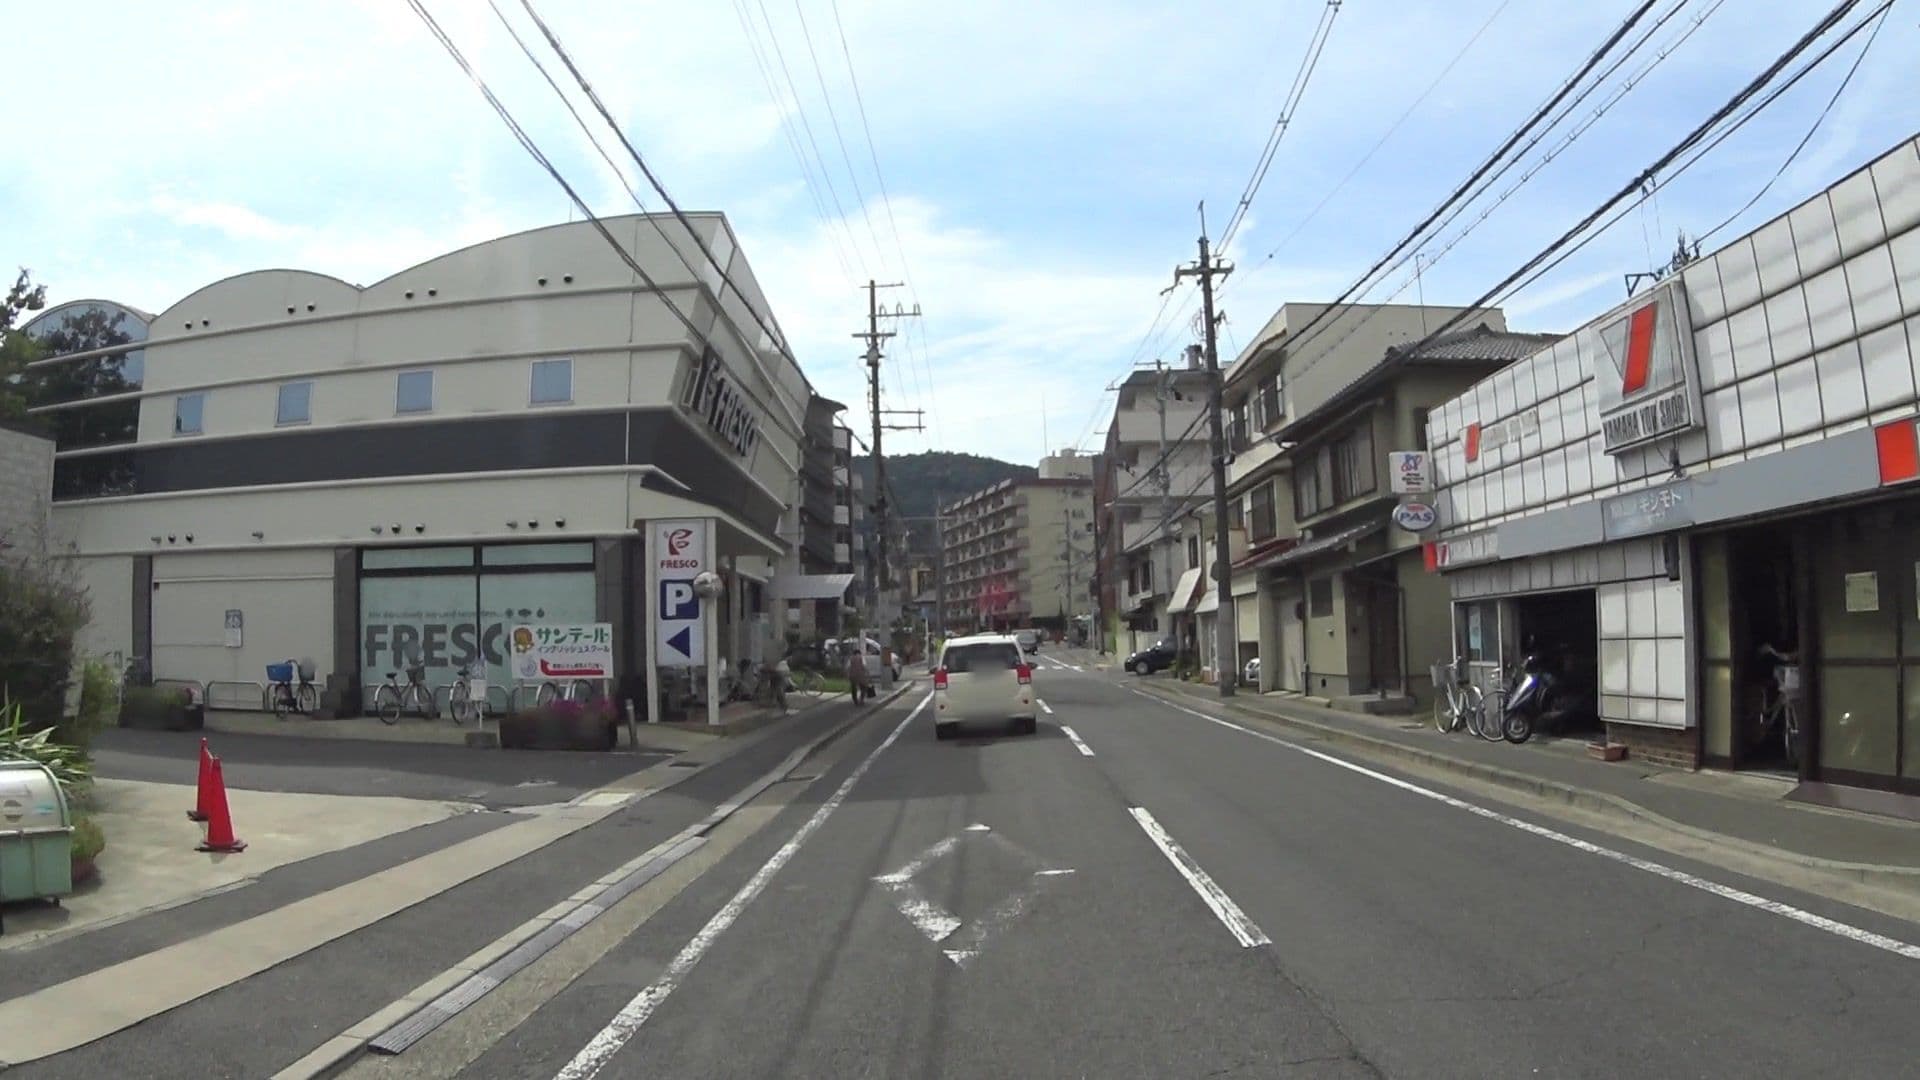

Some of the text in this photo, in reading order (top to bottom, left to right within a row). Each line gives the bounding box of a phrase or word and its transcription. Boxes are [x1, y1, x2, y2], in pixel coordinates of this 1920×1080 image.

[1400, 511, 1433, 522] PAS
[660, 559, 698, 568] FRESCO
[665, 583, 693, 616] P
[536, 627, 609, 644] サンテール
[365, 623, 511, 668] FRESC
